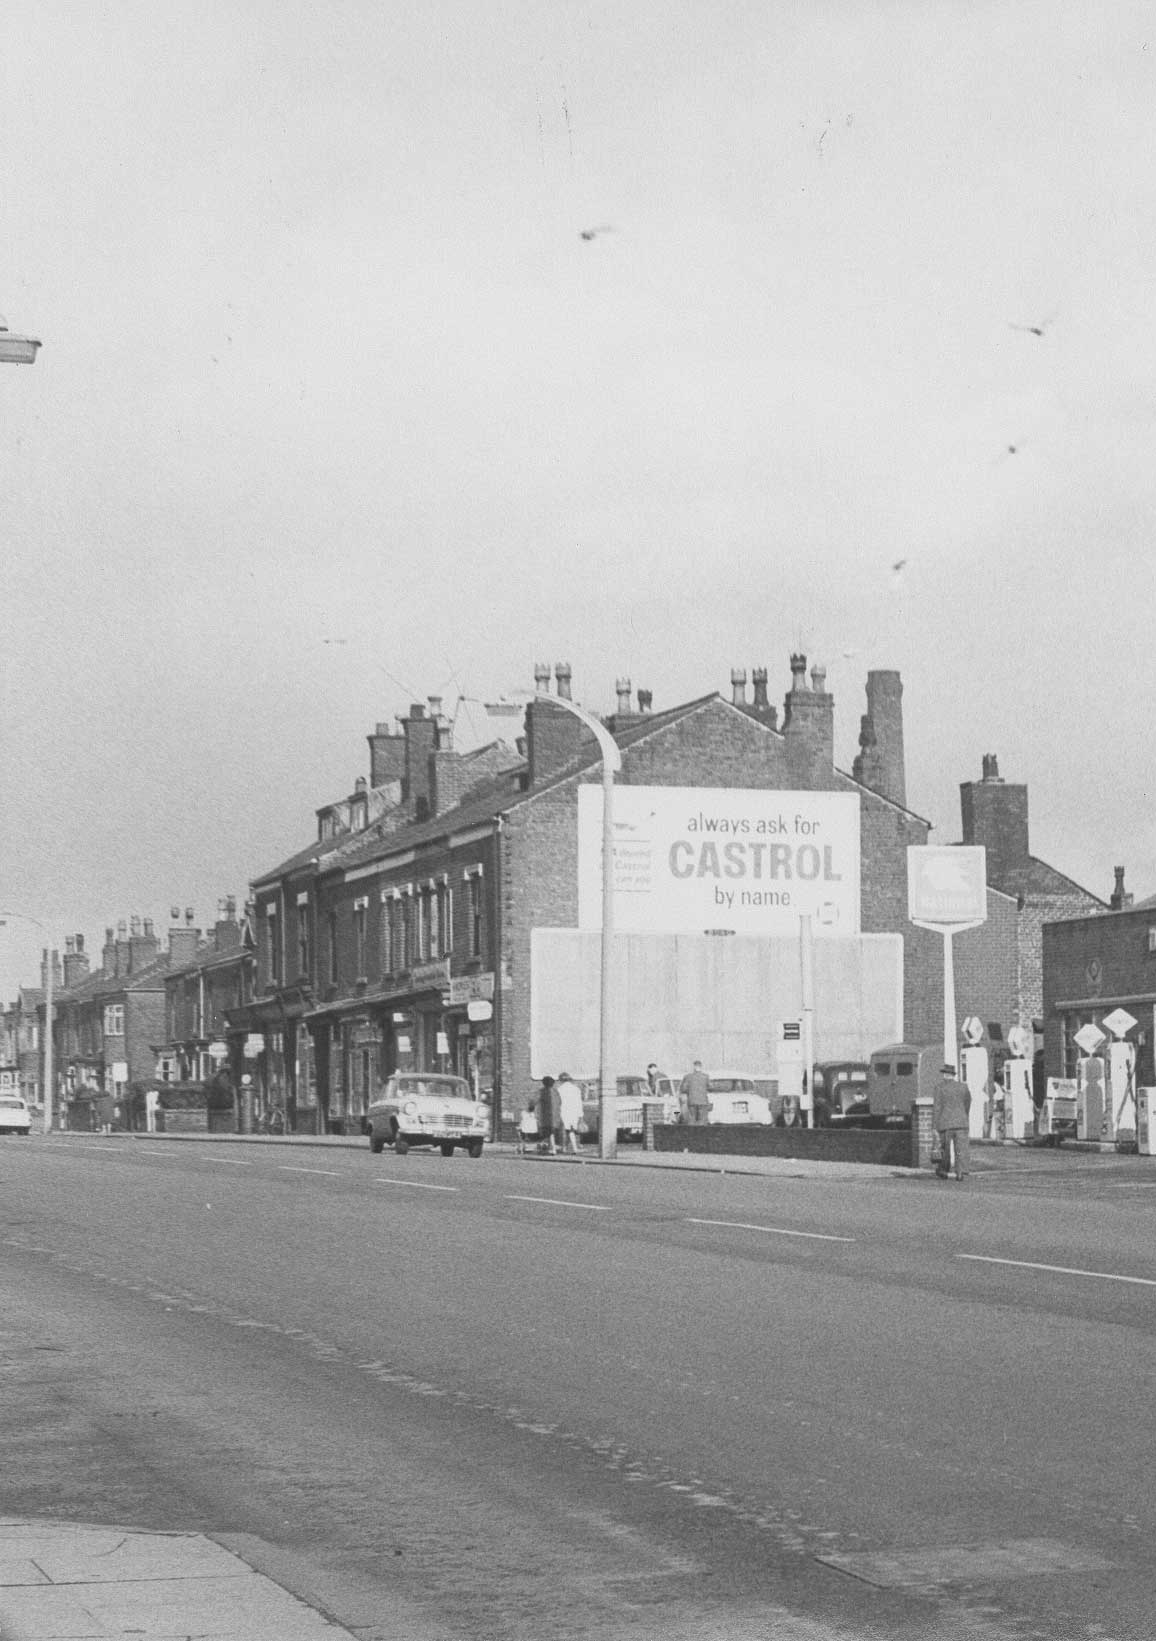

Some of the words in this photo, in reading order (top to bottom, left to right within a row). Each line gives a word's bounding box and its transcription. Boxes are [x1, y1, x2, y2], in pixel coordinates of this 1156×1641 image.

[688, 812, 750, 835] always
[756, 814, 788, 834] ask
[794, 814, 821, 835] for
[669, 840, 842, 880] CASTROL
[715, 886, 734, 908] by
[740, 889, 791, 906] name
